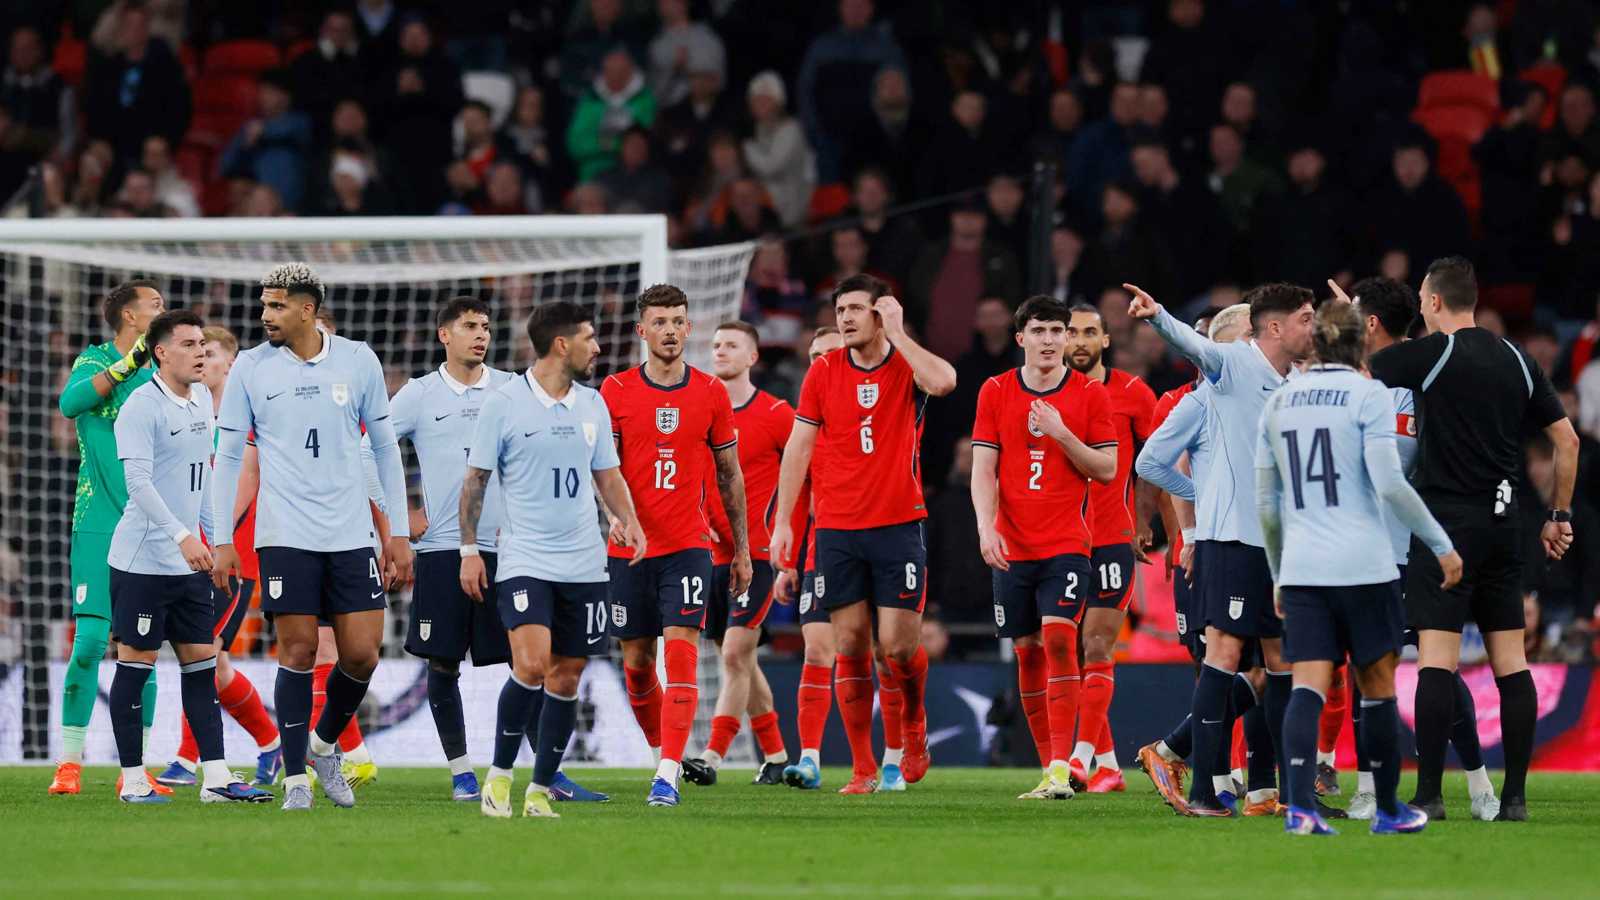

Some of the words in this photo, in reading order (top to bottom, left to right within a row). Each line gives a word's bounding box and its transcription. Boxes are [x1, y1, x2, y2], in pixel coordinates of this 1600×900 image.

[305, 428, 320, 458] 4
[860, 426, 874, 454] 6
[189, 462, 204, 492] 11
[552, 467, 580, 499] 10
[655, 459, 677, 489] 12
[1029, 461, 1043, 490] 2
[1281, 427, 1341, 509] 14
[369, 557, 382, 587] 4
[905, 562, 917, 590] 6
[1065, 571, 1078, 599] 2
[1098, 562, 1122, 590] 18
[681, 575, 703, 605] 12
[585, 600, 608, 634] 10
